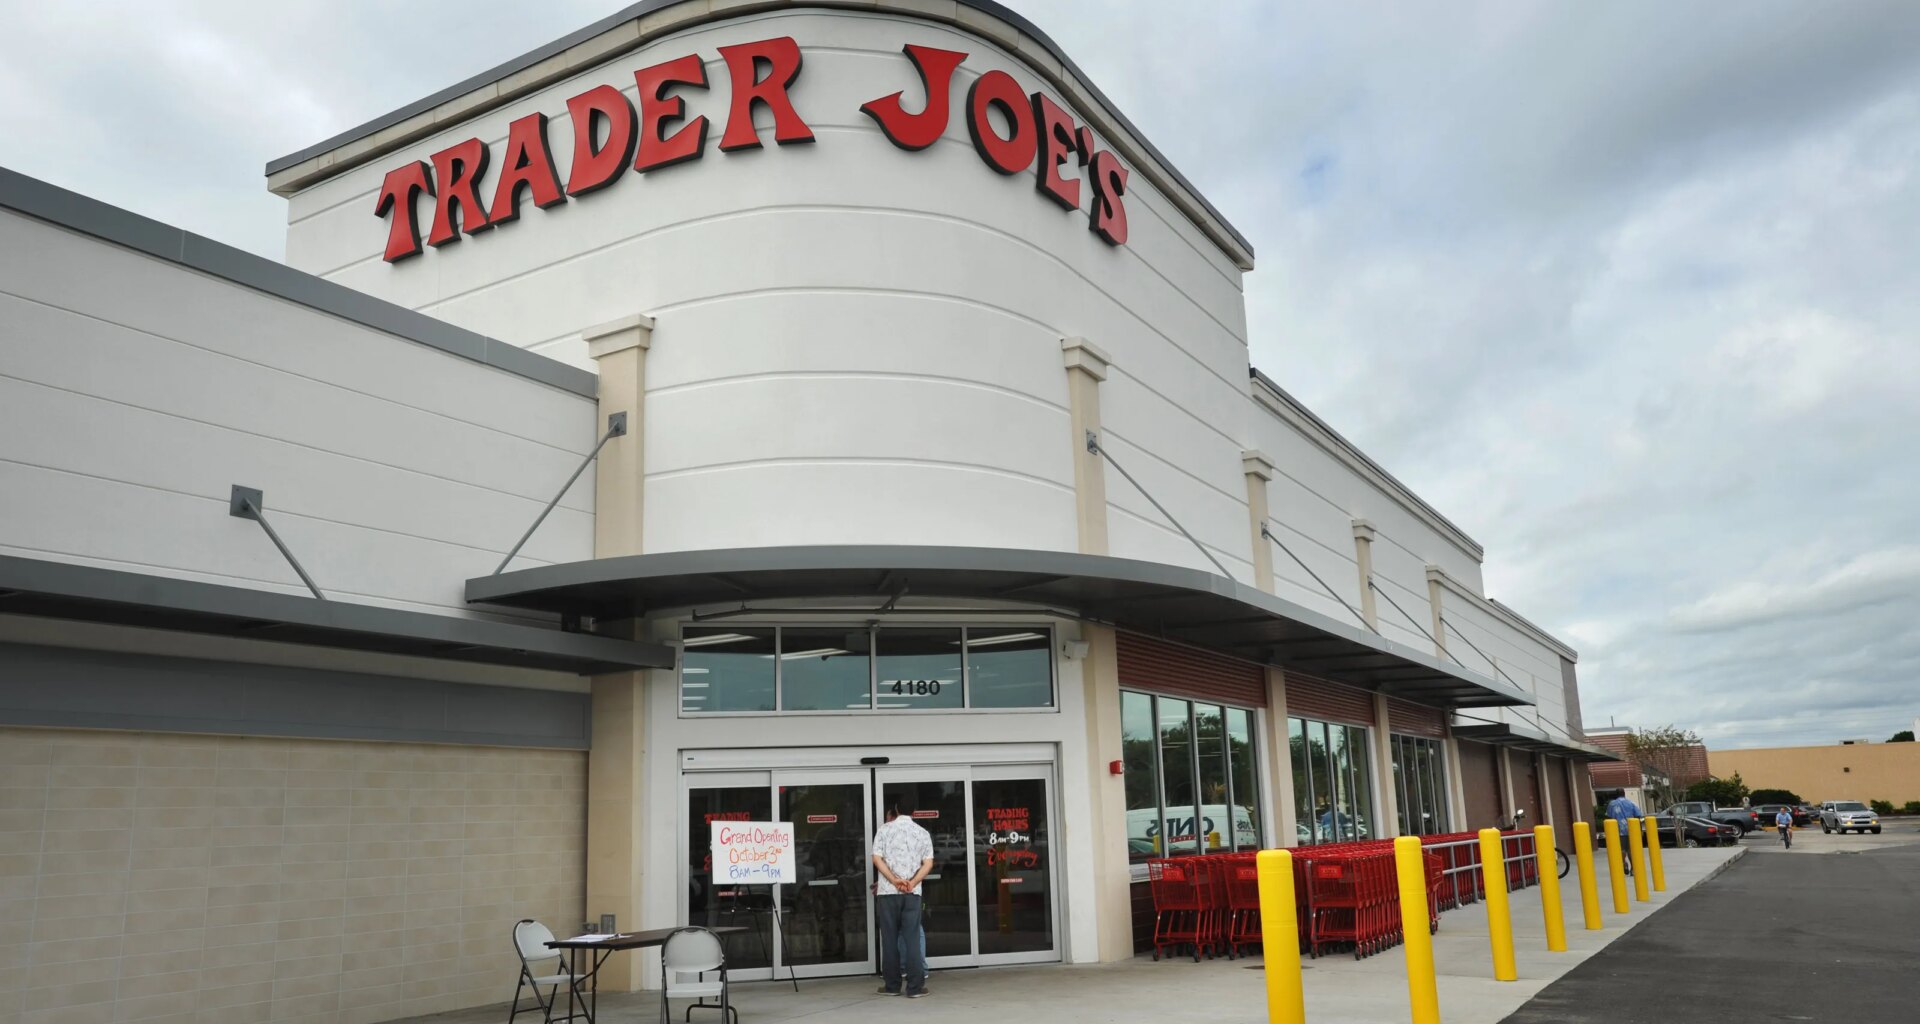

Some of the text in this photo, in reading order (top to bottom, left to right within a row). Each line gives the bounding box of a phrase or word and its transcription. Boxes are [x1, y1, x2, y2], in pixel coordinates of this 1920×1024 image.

[374, 36, 1129, 263] TRADER JOE'S
[891, 680, 941, 695] 4180
[987, 808, 1029, 819] TRADING
[993, 819, 1029, 830] HOURS
[720, 827, 789, 848] Grand Opening
[729, 847, 768, 864] October
